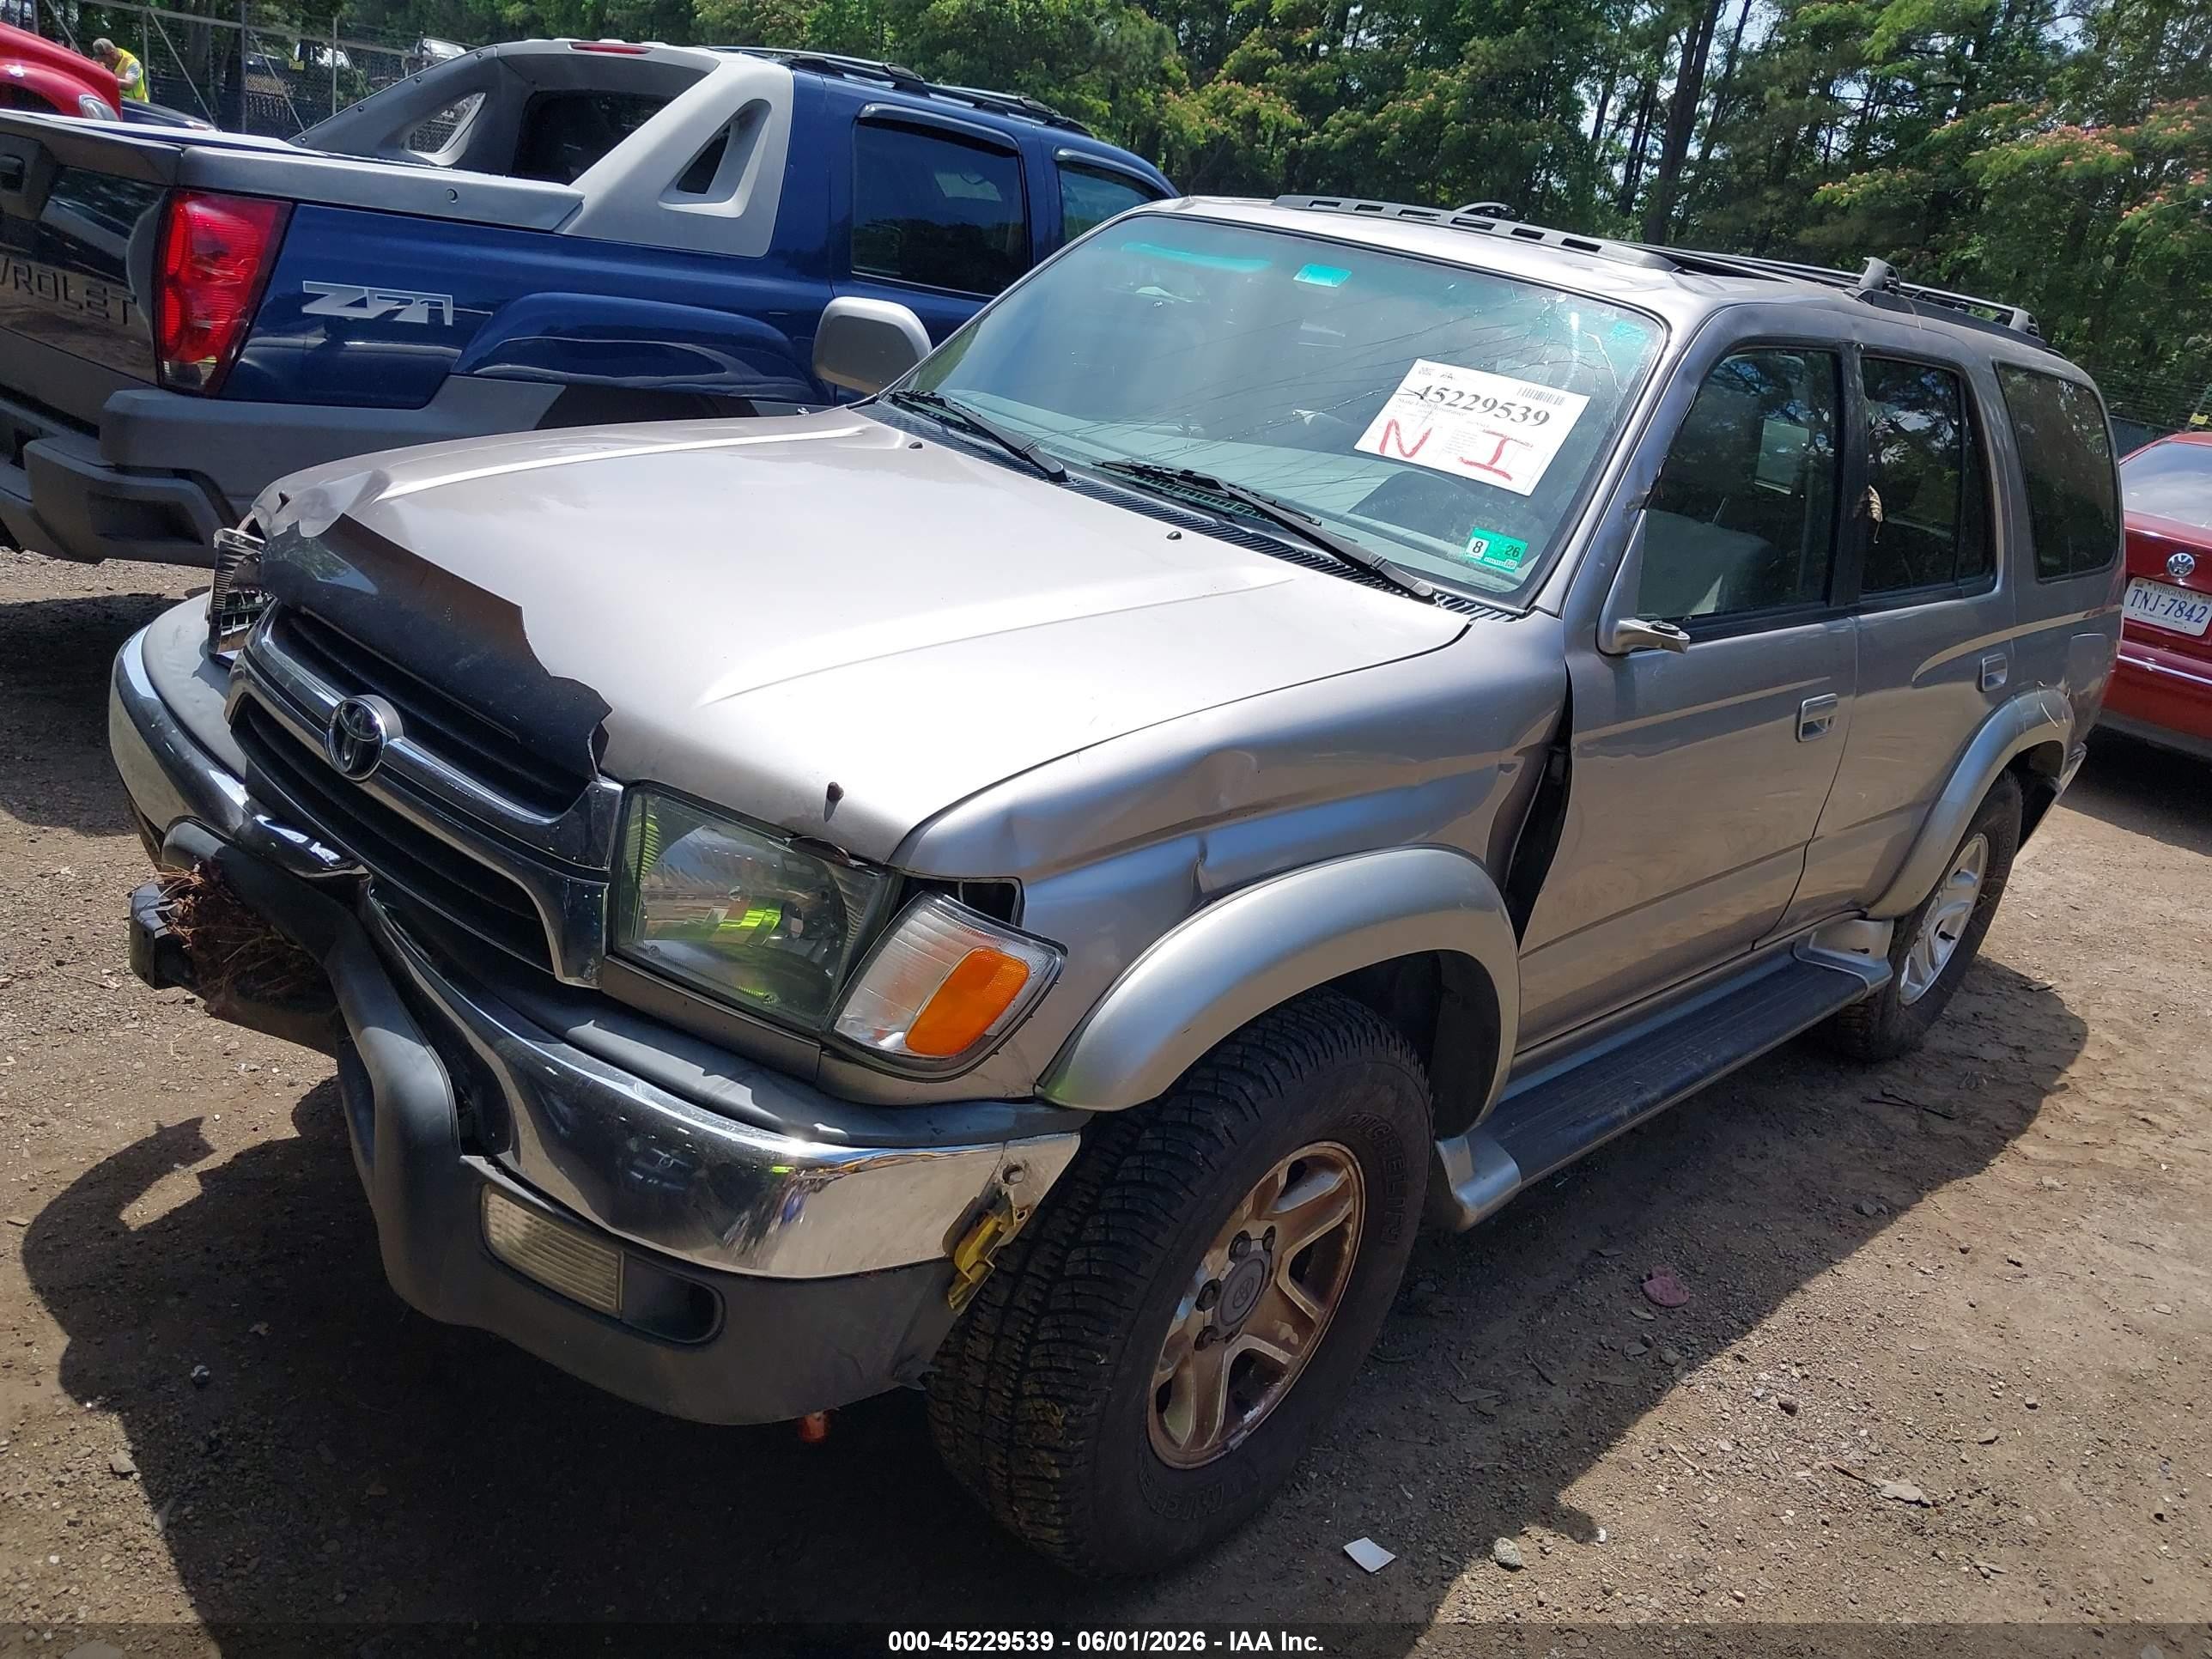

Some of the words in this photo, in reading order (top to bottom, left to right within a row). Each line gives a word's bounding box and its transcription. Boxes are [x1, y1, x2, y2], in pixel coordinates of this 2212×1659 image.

[302, 281, 453, 325] Z71
[1417, 386, 1550, 427] 45229539
[1379, 419, 1432, 458] N
[1473, 540, 1484, 554] 8
[1504, 544, 1522, 558] 26
[2130, 589, 2209, 623] TNJ-7842
[2154, 584, 2193, 601] VIRGINIA
[1343, 1109, 1409, 1244] MICHELIN
